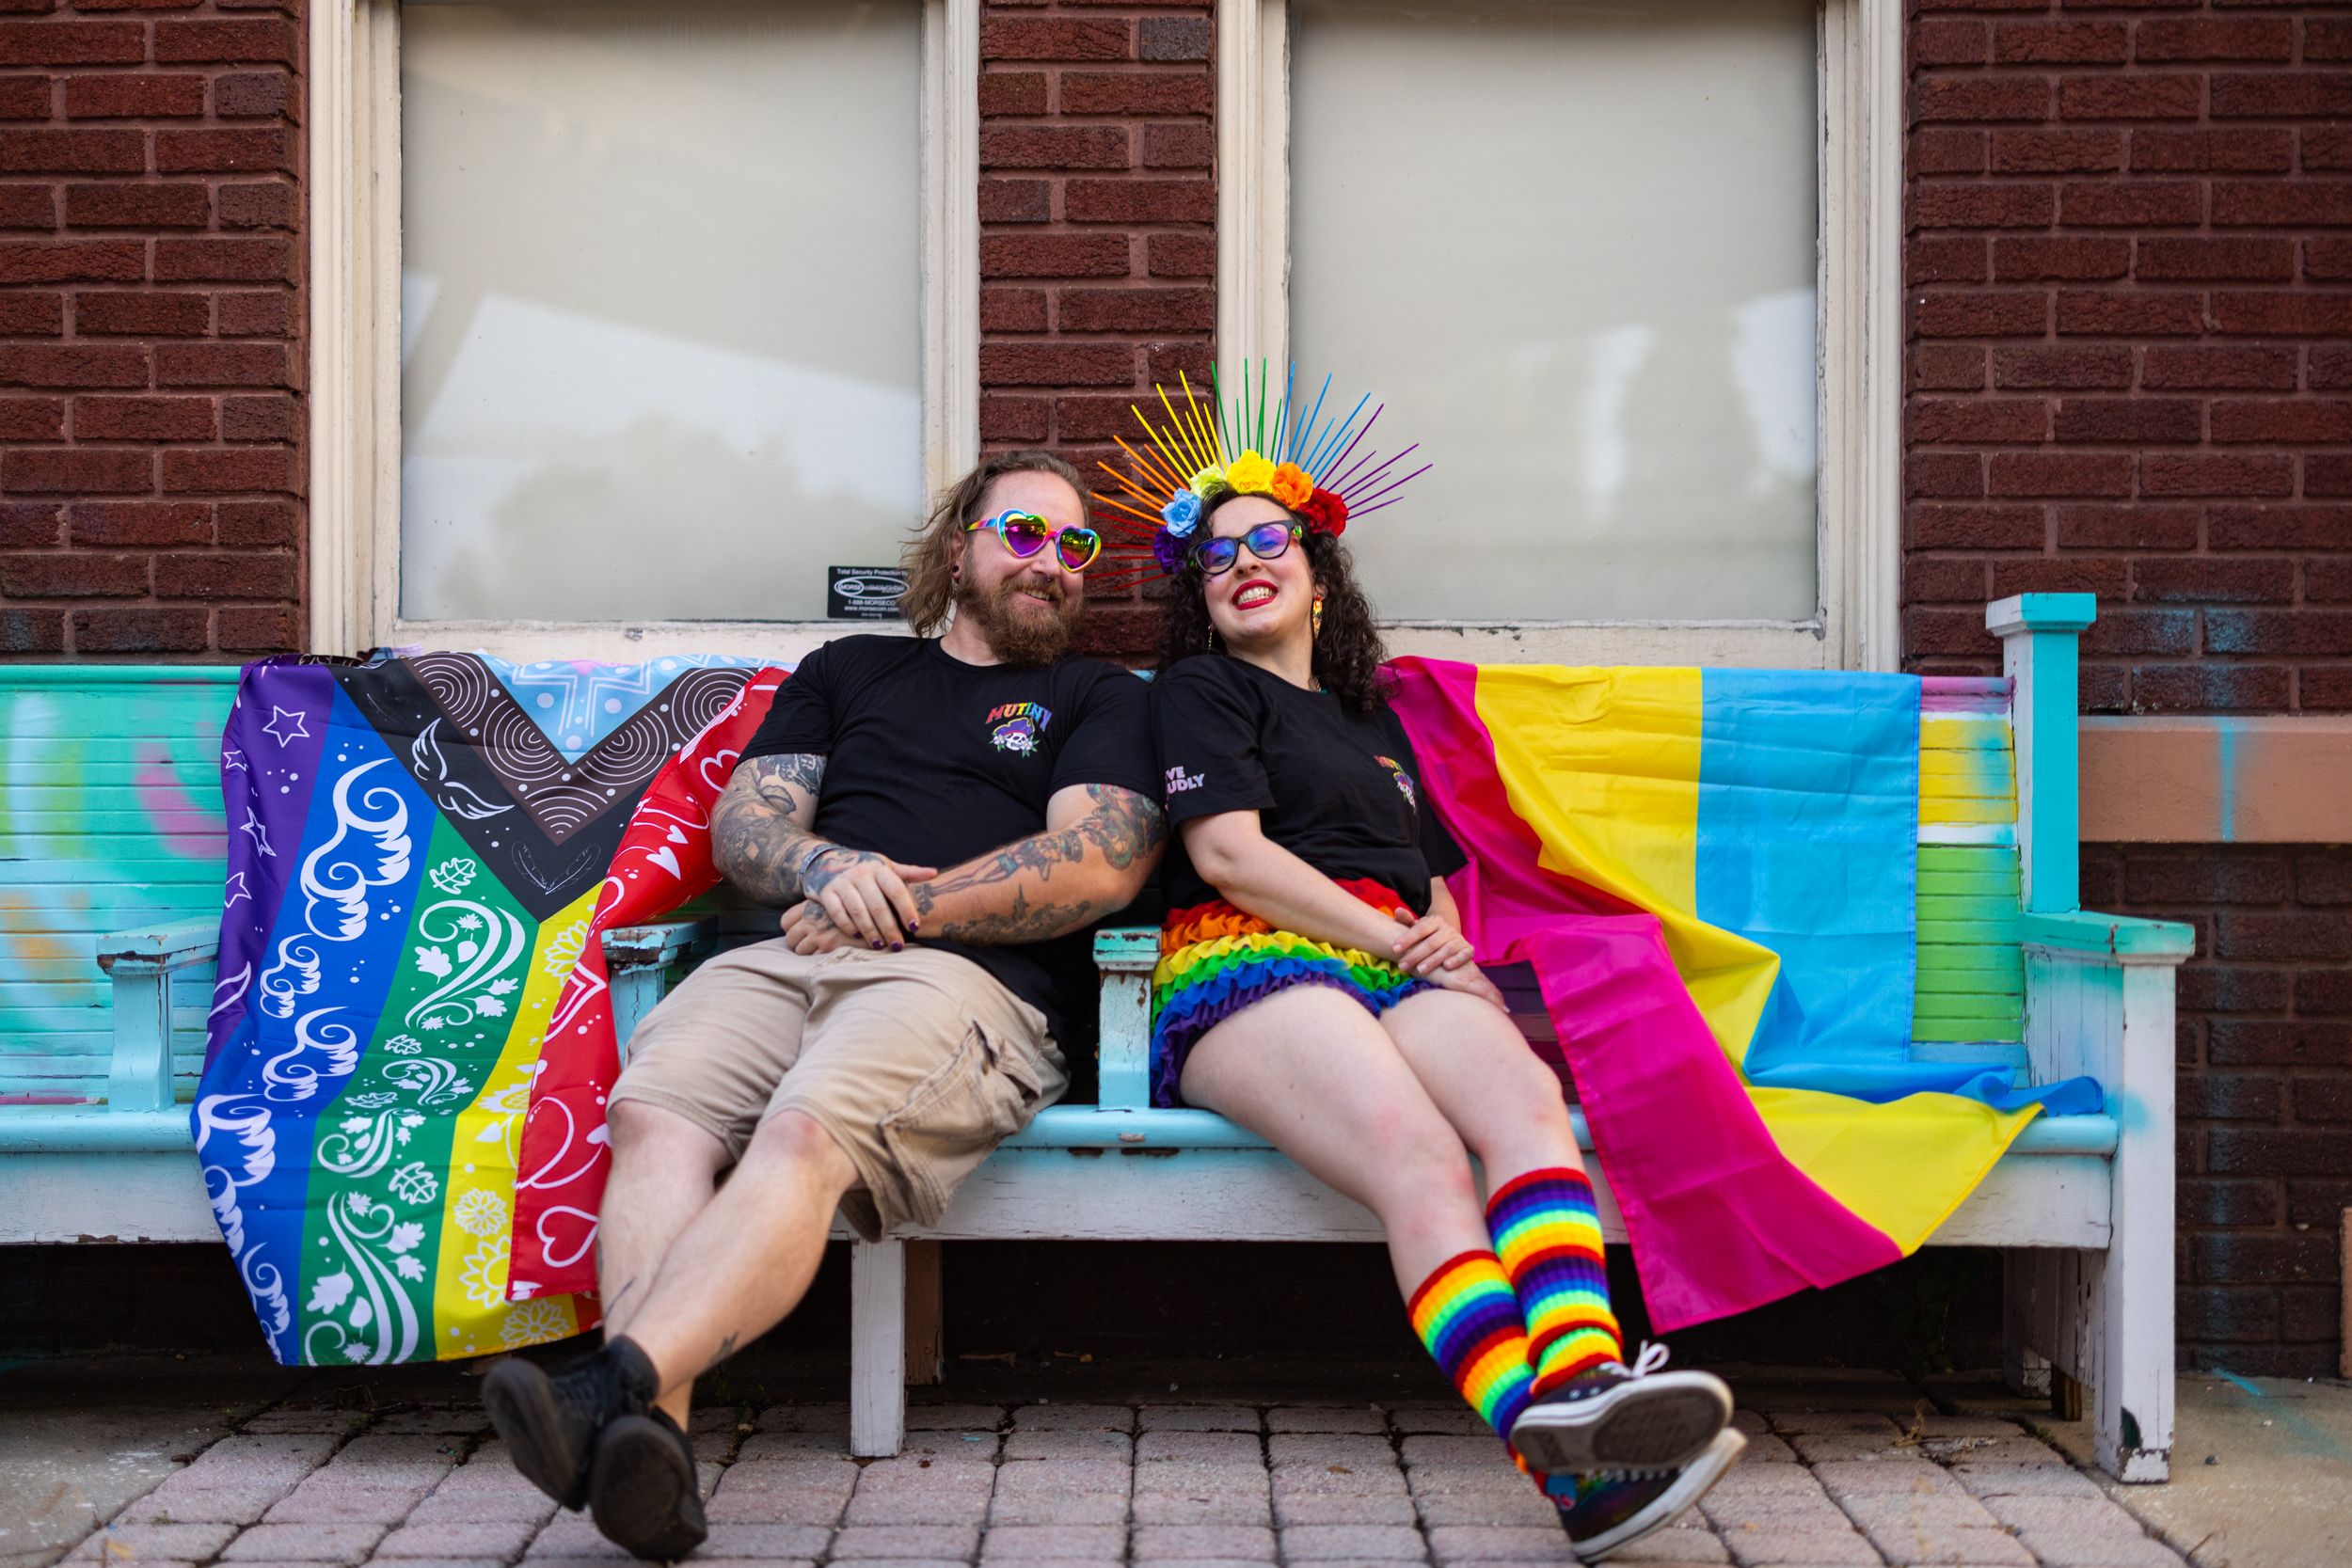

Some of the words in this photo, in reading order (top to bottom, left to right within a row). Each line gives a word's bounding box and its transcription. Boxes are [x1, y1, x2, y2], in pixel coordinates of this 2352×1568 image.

[985, 702, 1052, 733] MUTINY
[1166, 766, 1185, 781] VE
[1167, 773, 1205, 794] UDLY
